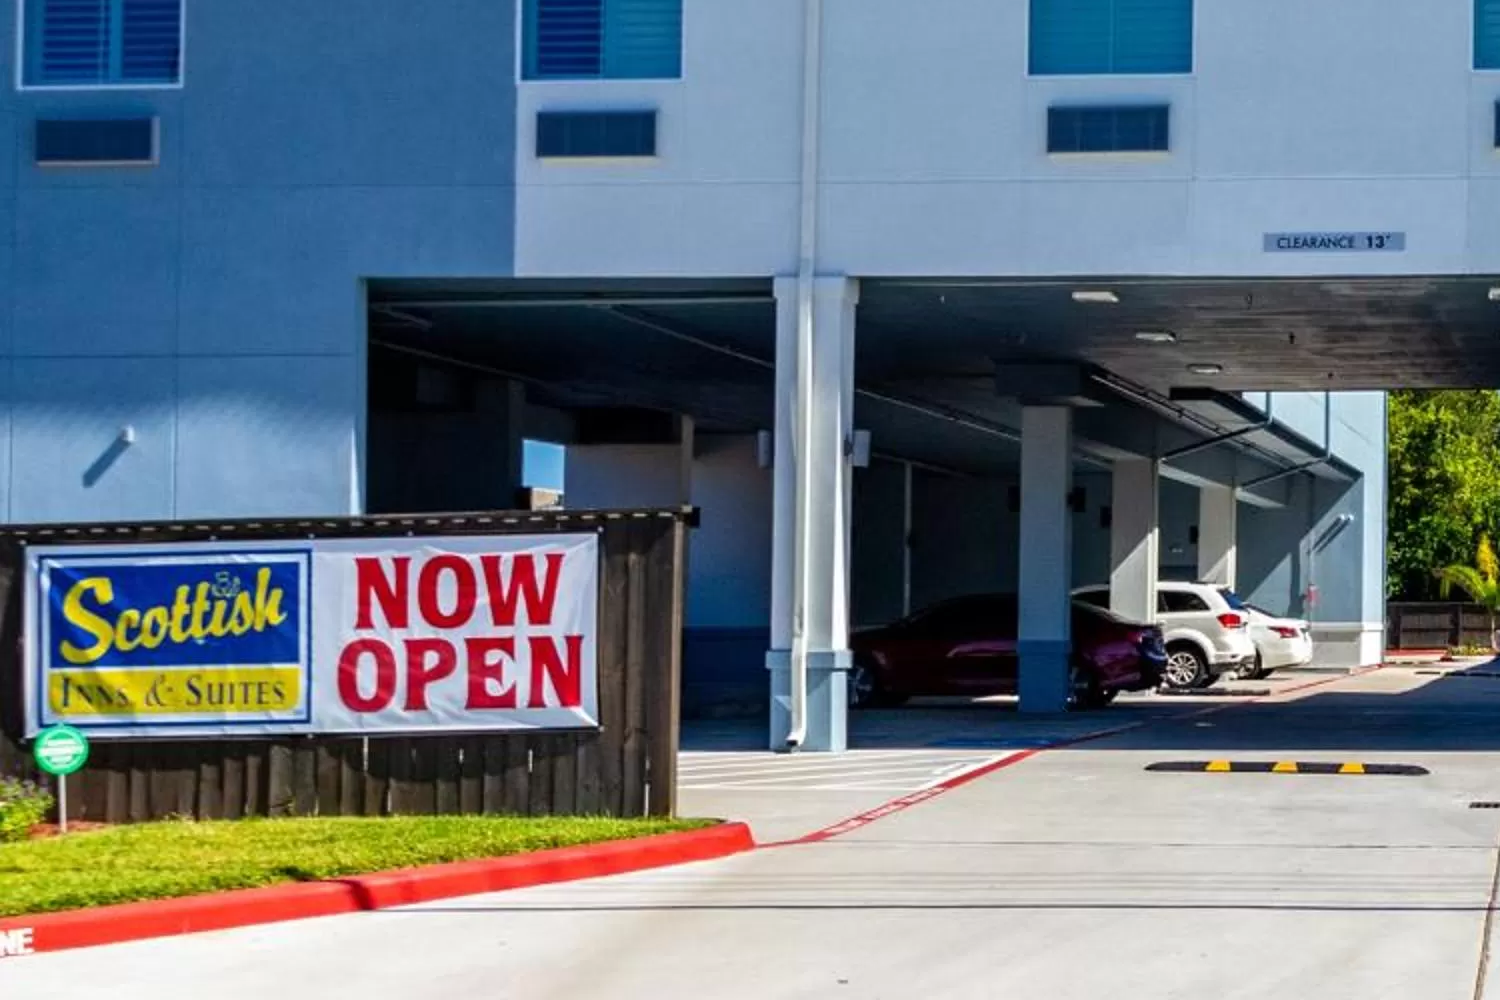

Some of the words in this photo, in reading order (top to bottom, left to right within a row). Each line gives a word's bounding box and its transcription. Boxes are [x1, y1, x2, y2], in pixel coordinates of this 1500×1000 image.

[1277, 236, 1354, 249] CLEARANCE
[60, 567, 287, 665] Scottish
[354, 553, 566, 630] NOW
[144, 675, 175, 707] &
[185, 673, 286, 707] SUITES
[336, 635, 585, 714] OPEN
